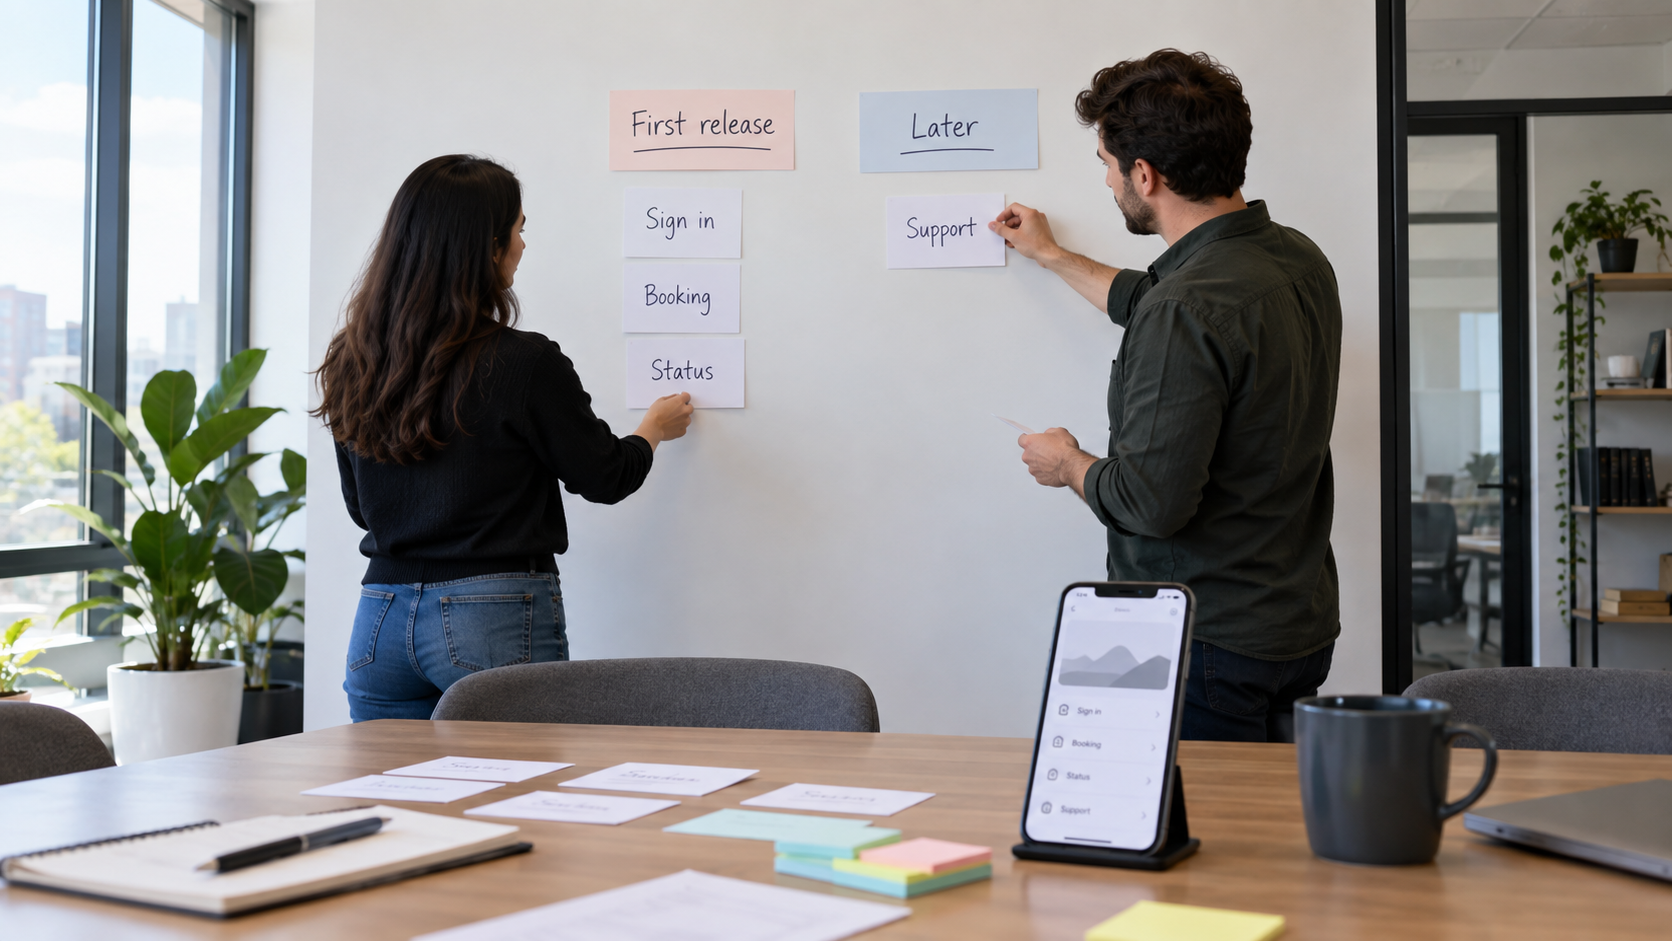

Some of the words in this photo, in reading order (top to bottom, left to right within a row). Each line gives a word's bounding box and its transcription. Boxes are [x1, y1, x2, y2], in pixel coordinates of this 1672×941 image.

[632, 109, 687, 137] First
[700, 109, 775, 135] release
[912, 112, 979, 139] Later
[646, 206, 688, 240] Sign
[699, 211, 715, 229] in
[906, 216, 977, 248] Support
[644, 283, 711, 316] Booking
[651, 358, 714, 381] Status
[1077, 706, 1094, 717] Sign
[1095, 708, 1102, 716] in
[1071, 739, 1102, 750] Booking
[1066, 771, 1091, 781] Status
[1060, 804, 1091, 815] Support
